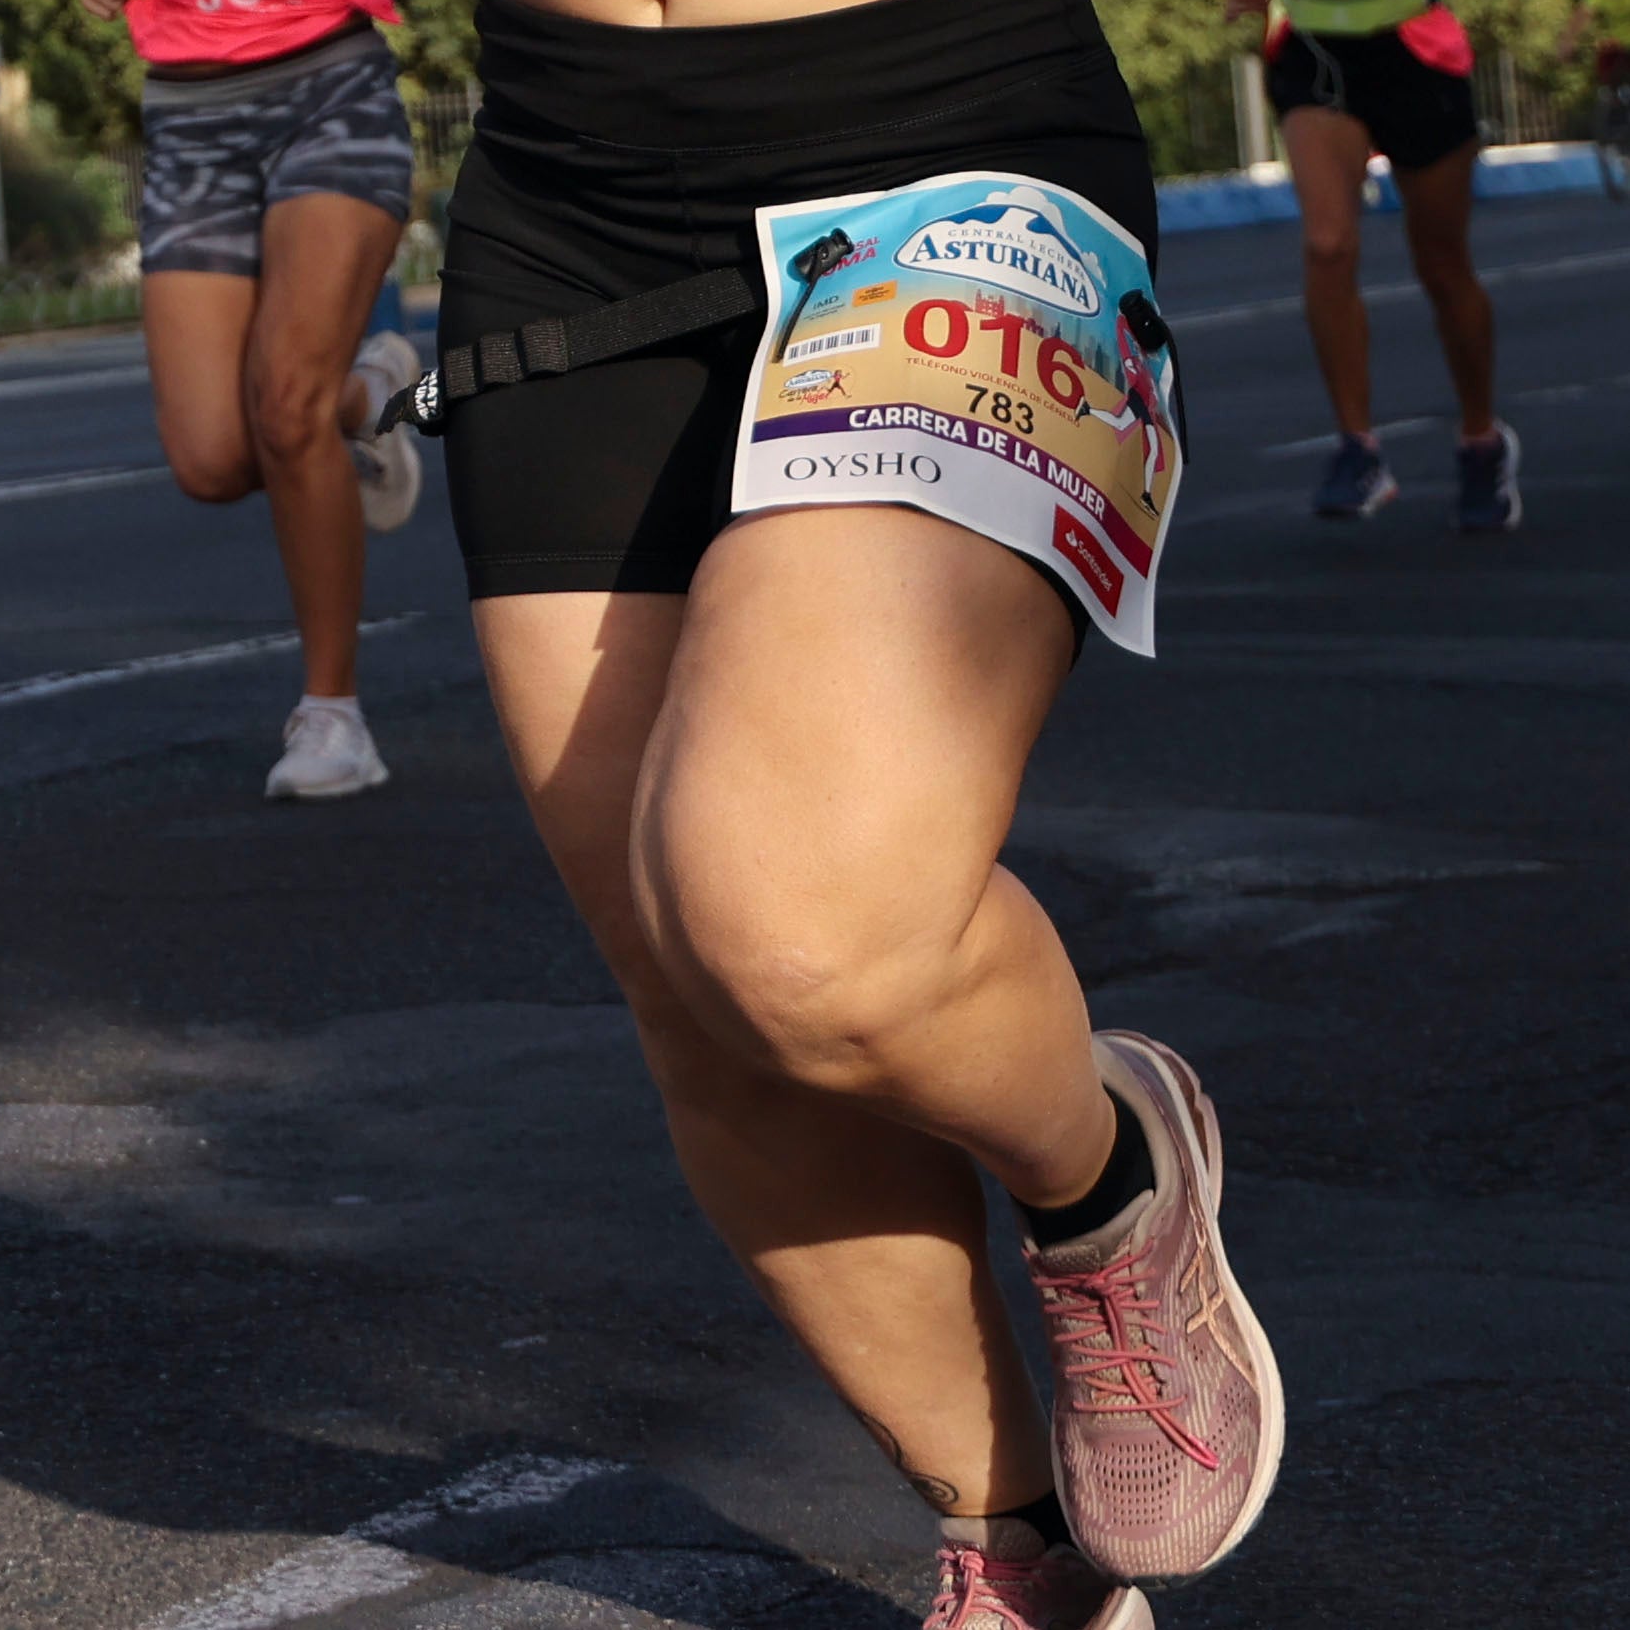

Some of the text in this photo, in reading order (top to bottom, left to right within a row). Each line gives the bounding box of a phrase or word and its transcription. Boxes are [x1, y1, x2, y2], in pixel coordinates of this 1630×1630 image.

[909, 233, 1091, 310] ASTURIANA
[947, 229, 1086, 281] CENTRAL LECHERA
[903, 298, 1086, 410] 016
[965, 383, 1034, 435] 783
[969, 370, 1029, 397] VIOLENCIA
[1029, 392, 1041, 404] DE
[784, 452, 942, 484] OYSHO
[849, 406, 1106, 520] CARRERA DE LA MUJER
